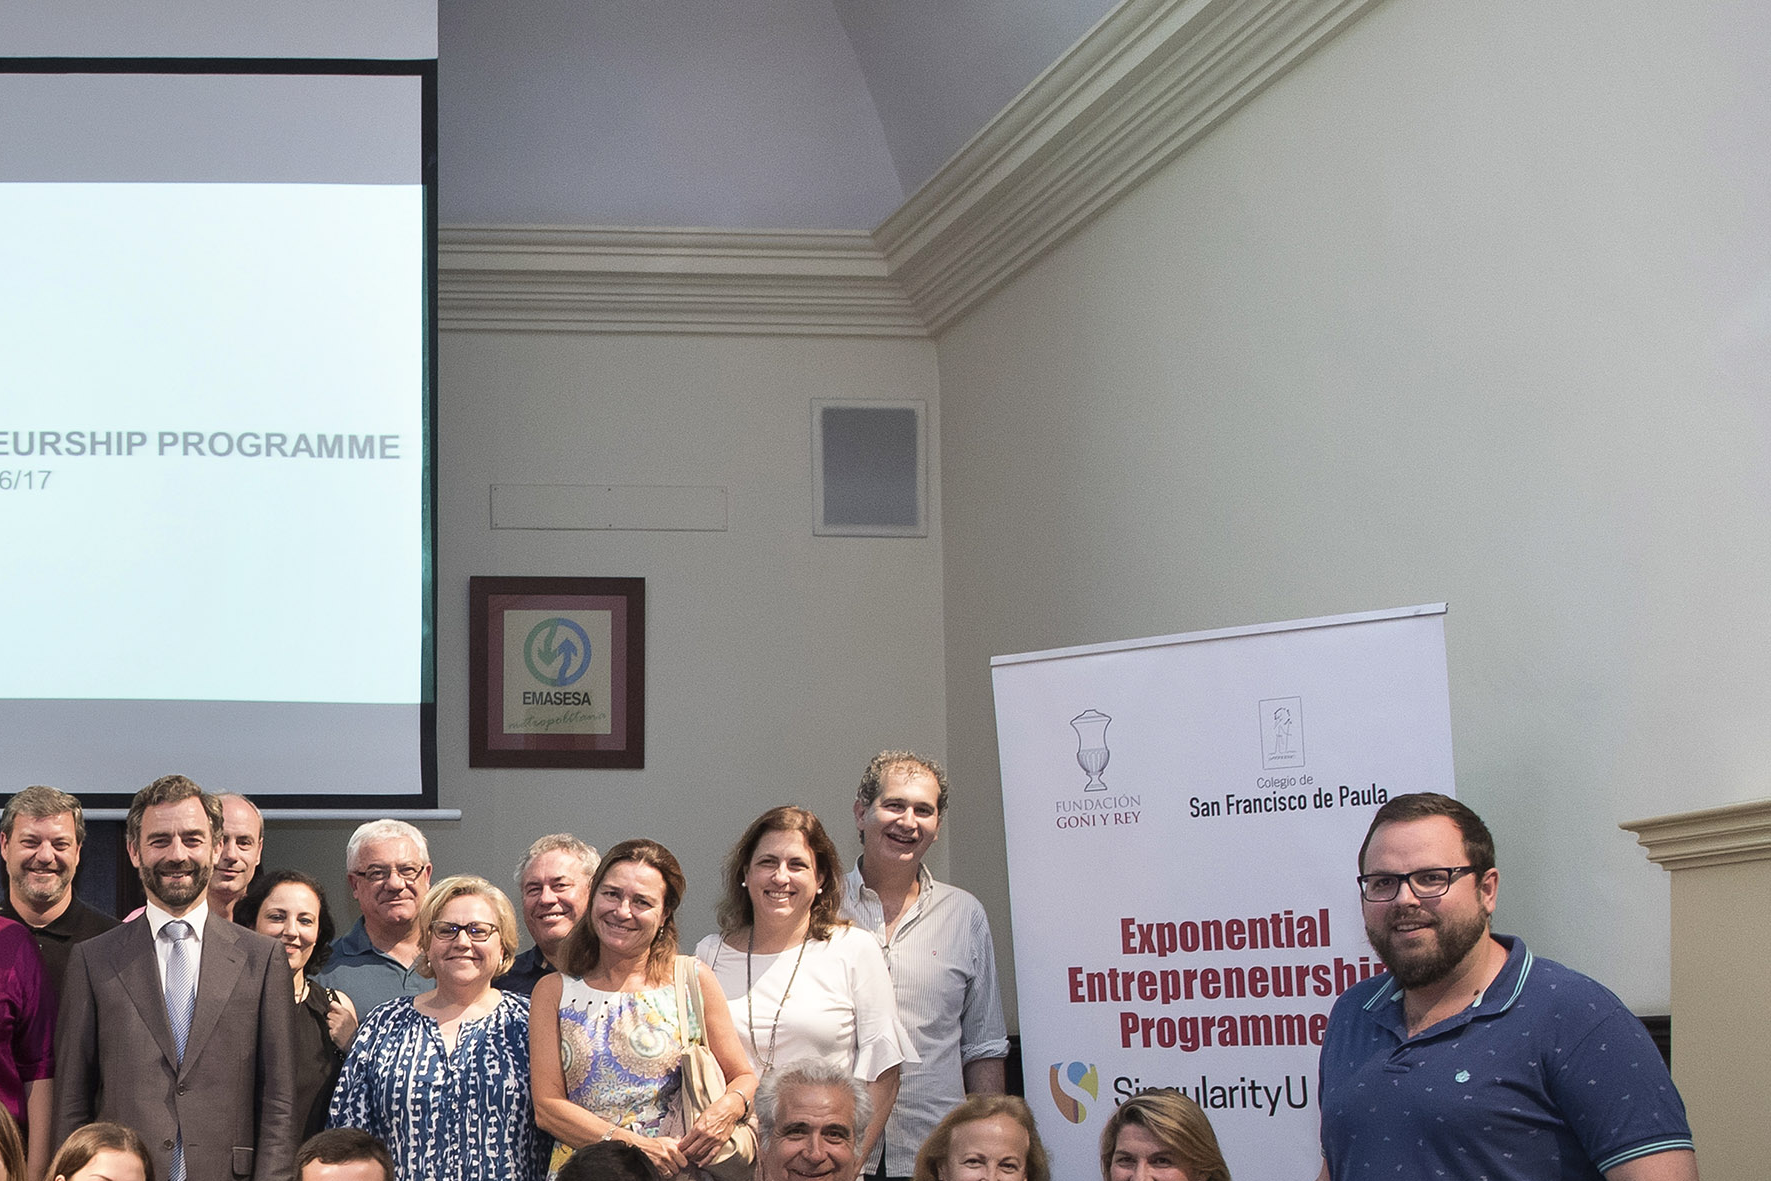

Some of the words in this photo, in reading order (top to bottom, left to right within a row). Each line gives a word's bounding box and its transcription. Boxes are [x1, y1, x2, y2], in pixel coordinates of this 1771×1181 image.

[158, 430, 401, 461] PROGRAMME
[522, 691, 592, 706] EMASESA
[1256, 776, 1297, 790] Colegio
[1299, 774, 1314, 785] de
[1055, 793, 1141, 813] FUNDACIÓN
[1189, 796, 1221, 818] San
[1225, 791, 1307, 816] Francisco
[1312, 787, 1334, 809] de
[1338, 783, 1388, 808] Paula
[1056, 812, 1096, 829] GOÑI
[1100, 813, 1110, 826] Y
[1114, 811, 1141, 825] REY
[1120, 908, 1331, 958] Exponential
[1067, 956, 1389, 1005] Entrepreneurshi
[1119, 1011, 1329, 1053] Programme
